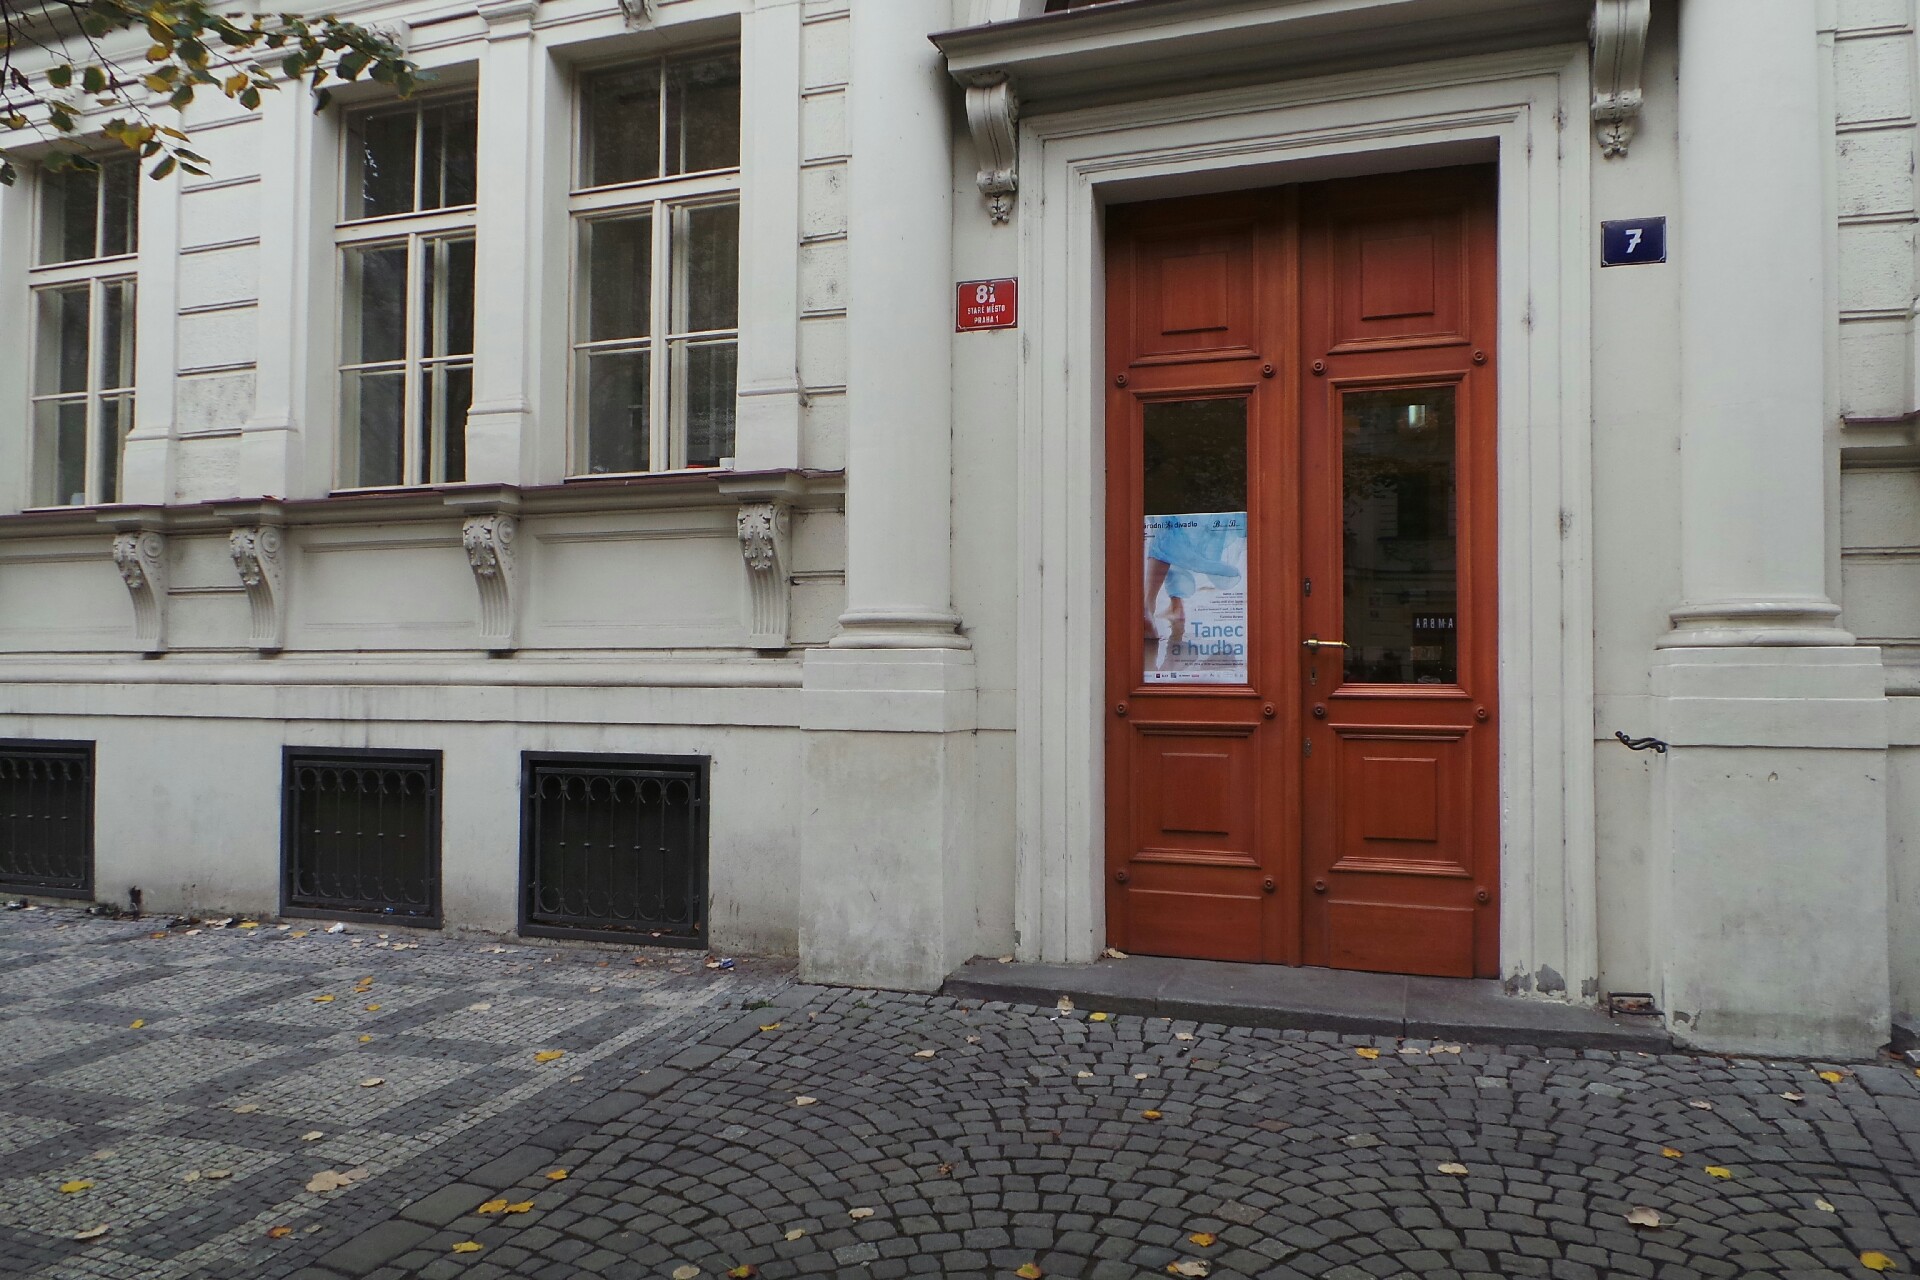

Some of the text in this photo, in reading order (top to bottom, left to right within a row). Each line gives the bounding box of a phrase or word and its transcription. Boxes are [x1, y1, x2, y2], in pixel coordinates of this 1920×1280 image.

[1625, 228, 1643, 254] 7
[967, 304, 1006, 315] STARÉ MĚSTO
[973, 315, 999, 324] PRAHA 1
[1174, 520, 1198, 529] divadlo
[1191, 621, 1244, 638] Tanec
[1171, 640, 1244, 656] a hudba
